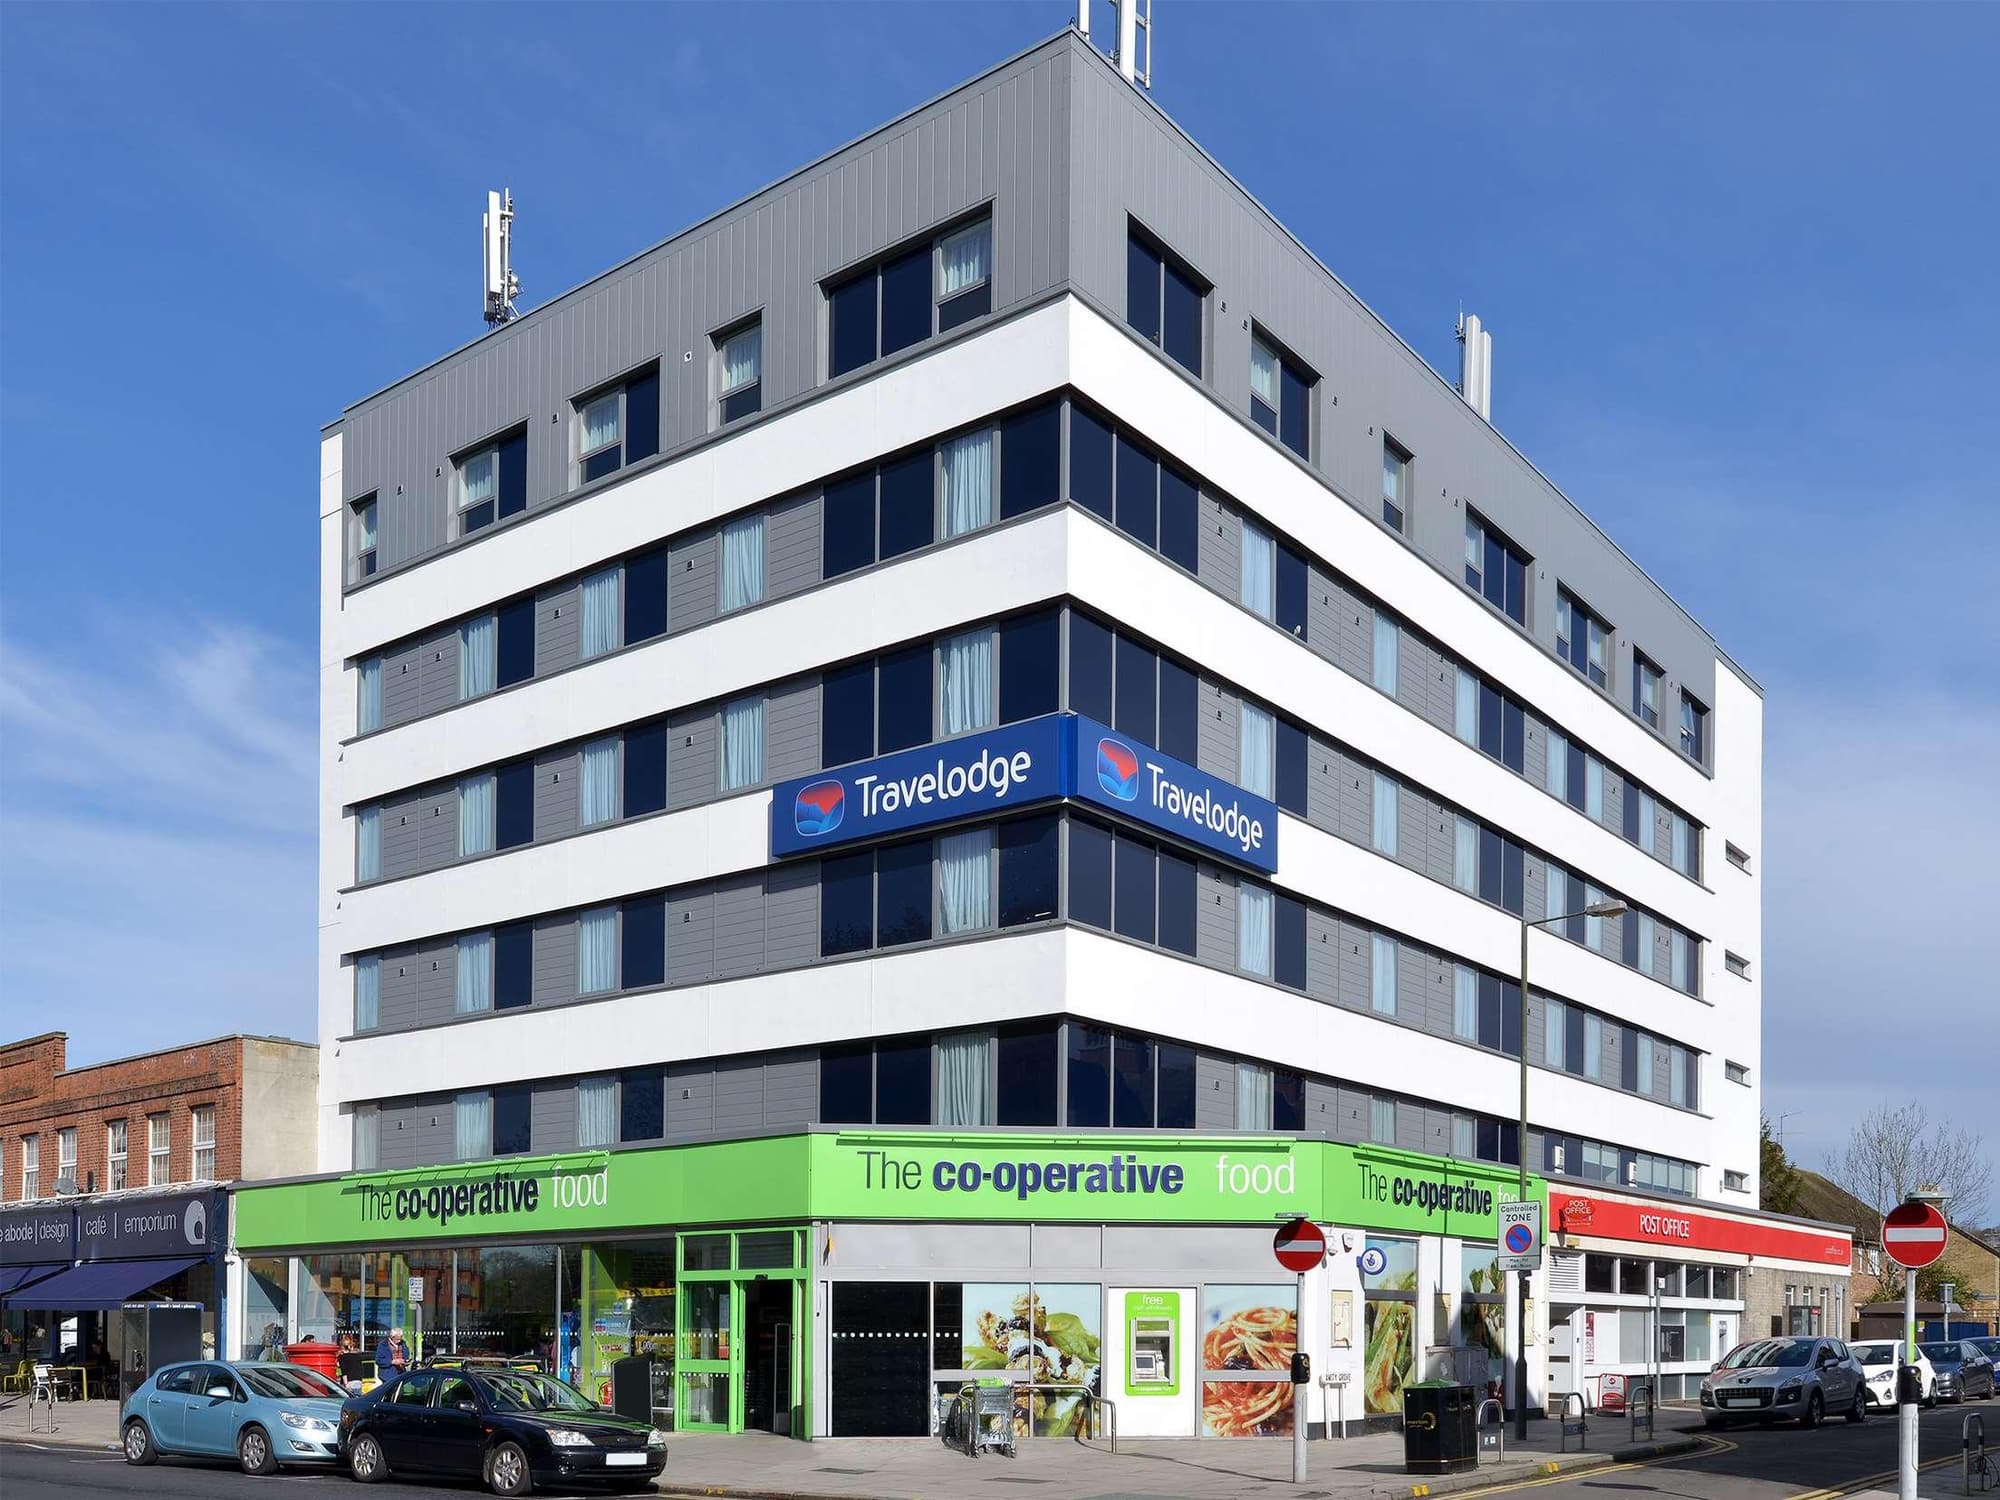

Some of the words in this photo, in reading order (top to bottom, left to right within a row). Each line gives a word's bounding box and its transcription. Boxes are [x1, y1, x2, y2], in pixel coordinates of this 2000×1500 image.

[855, 749, 1031, 818] Travelodge
[1147, 761, 1263, 852] Travelodge
[857, 1151, 922, 1190] The
[932, 1154, 1184, 1201] co-operative
[1215, 1155, 1296, 1194] food
[358, 1184, 392, 1222] The
[396, 1172, 539, 1226] co-operative
[551, 1161, 608, 1209] food
[1358, 1164, 1388, 1202] The
[1393, 1177, 1492, 1217] co-operative
[1568, 1199, 1589, 1207] POST
[1501, 1205, 1538, 1213] Controlled
[1506, 1213, 1532, 1222] ZONE
[1565, 1206, 1592, 1214] OFFICE
[5, 1224, 33, 1242] abode
[39, 1219, 69, 1243] design
[85, 1216, 107, 1236] café
[124, 1211, 177, 1237] emporium
[1640, 1214, 1660, 1234] POST
[1662, 1217, 1690, 1238] OFFICE
[1142, 1294, 1163, 1305] free
